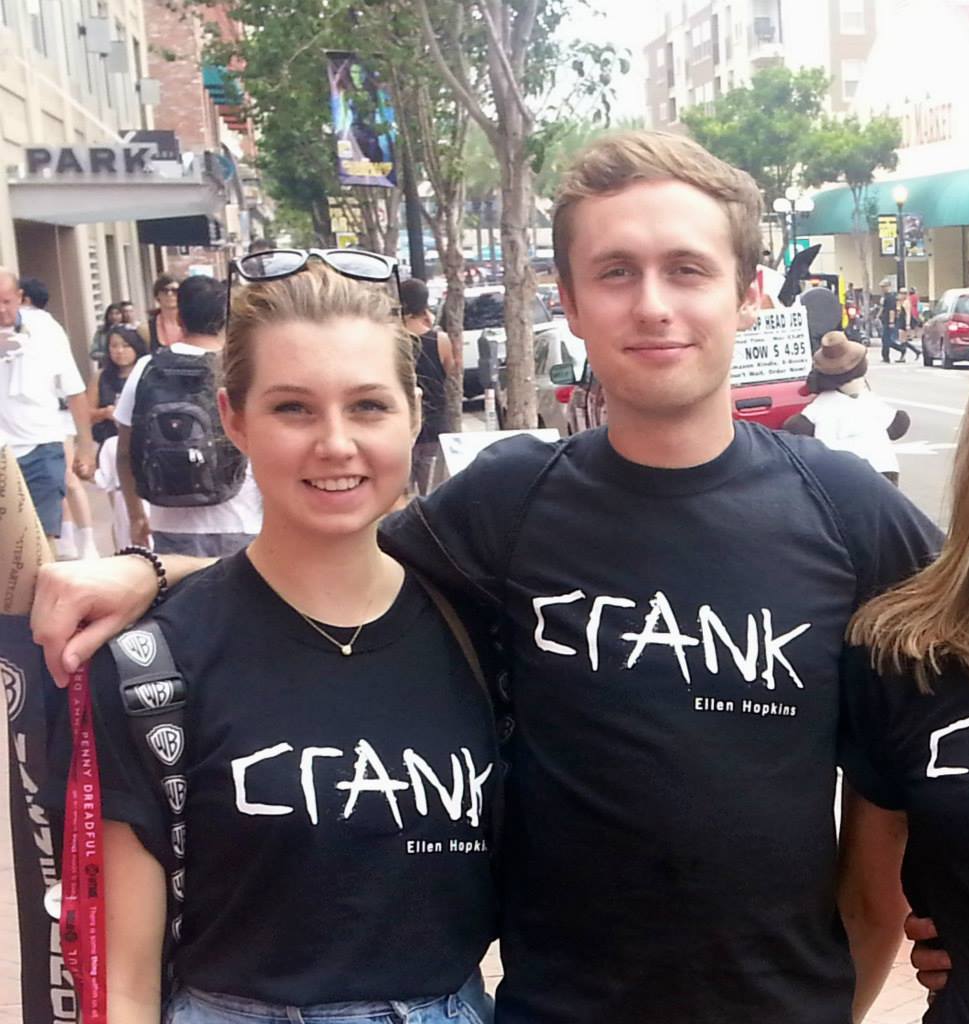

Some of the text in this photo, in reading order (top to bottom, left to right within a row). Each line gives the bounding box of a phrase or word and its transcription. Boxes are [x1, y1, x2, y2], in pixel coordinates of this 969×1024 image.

[26, 147, 152, 174] PARK
[765, 314, 786, 330] HEAD
[790, 312, 802, 327] JED
[745, 345, 768, 360] NOW
[785, 342, 806, 356] 4.95
[694, 697, 797, 717] Ellen Hopkins
[80, 731, 93, 777] PENNY
[83, 785, 96, 857] DREADFUL
[407, 841, 442, 854] Ellen
